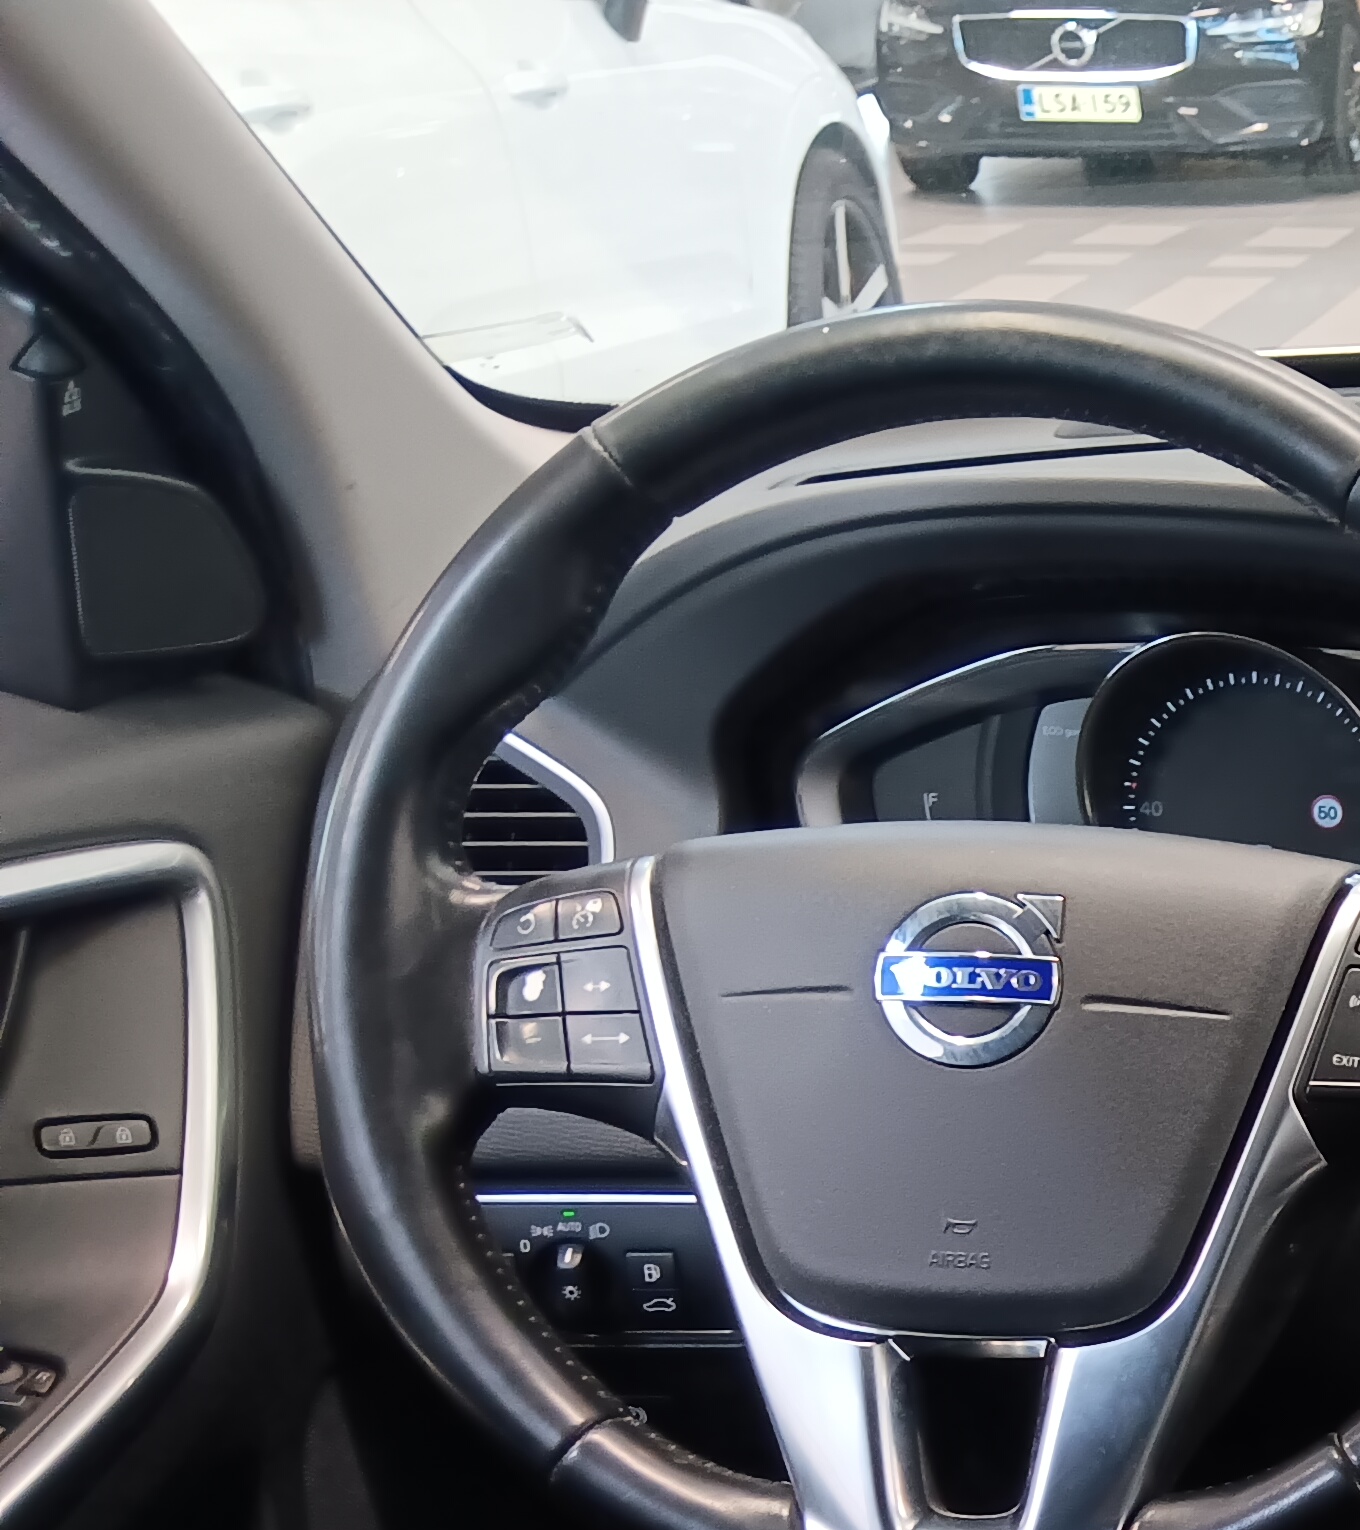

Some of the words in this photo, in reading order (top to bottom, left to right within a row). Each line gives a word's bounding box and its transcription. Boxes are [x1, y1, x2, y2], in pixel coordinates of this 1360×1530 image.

[1139, 801, 1163, 817] 40
[1318, 805, 1338, 821] 50
[890, 957, 1042, 995] VOLVO
[1332, 1054, 1360, 1068] EXIT
[556, 1221, 582, 1233] AUTO
[929, 1250, 991, 1270] AIRBAG
